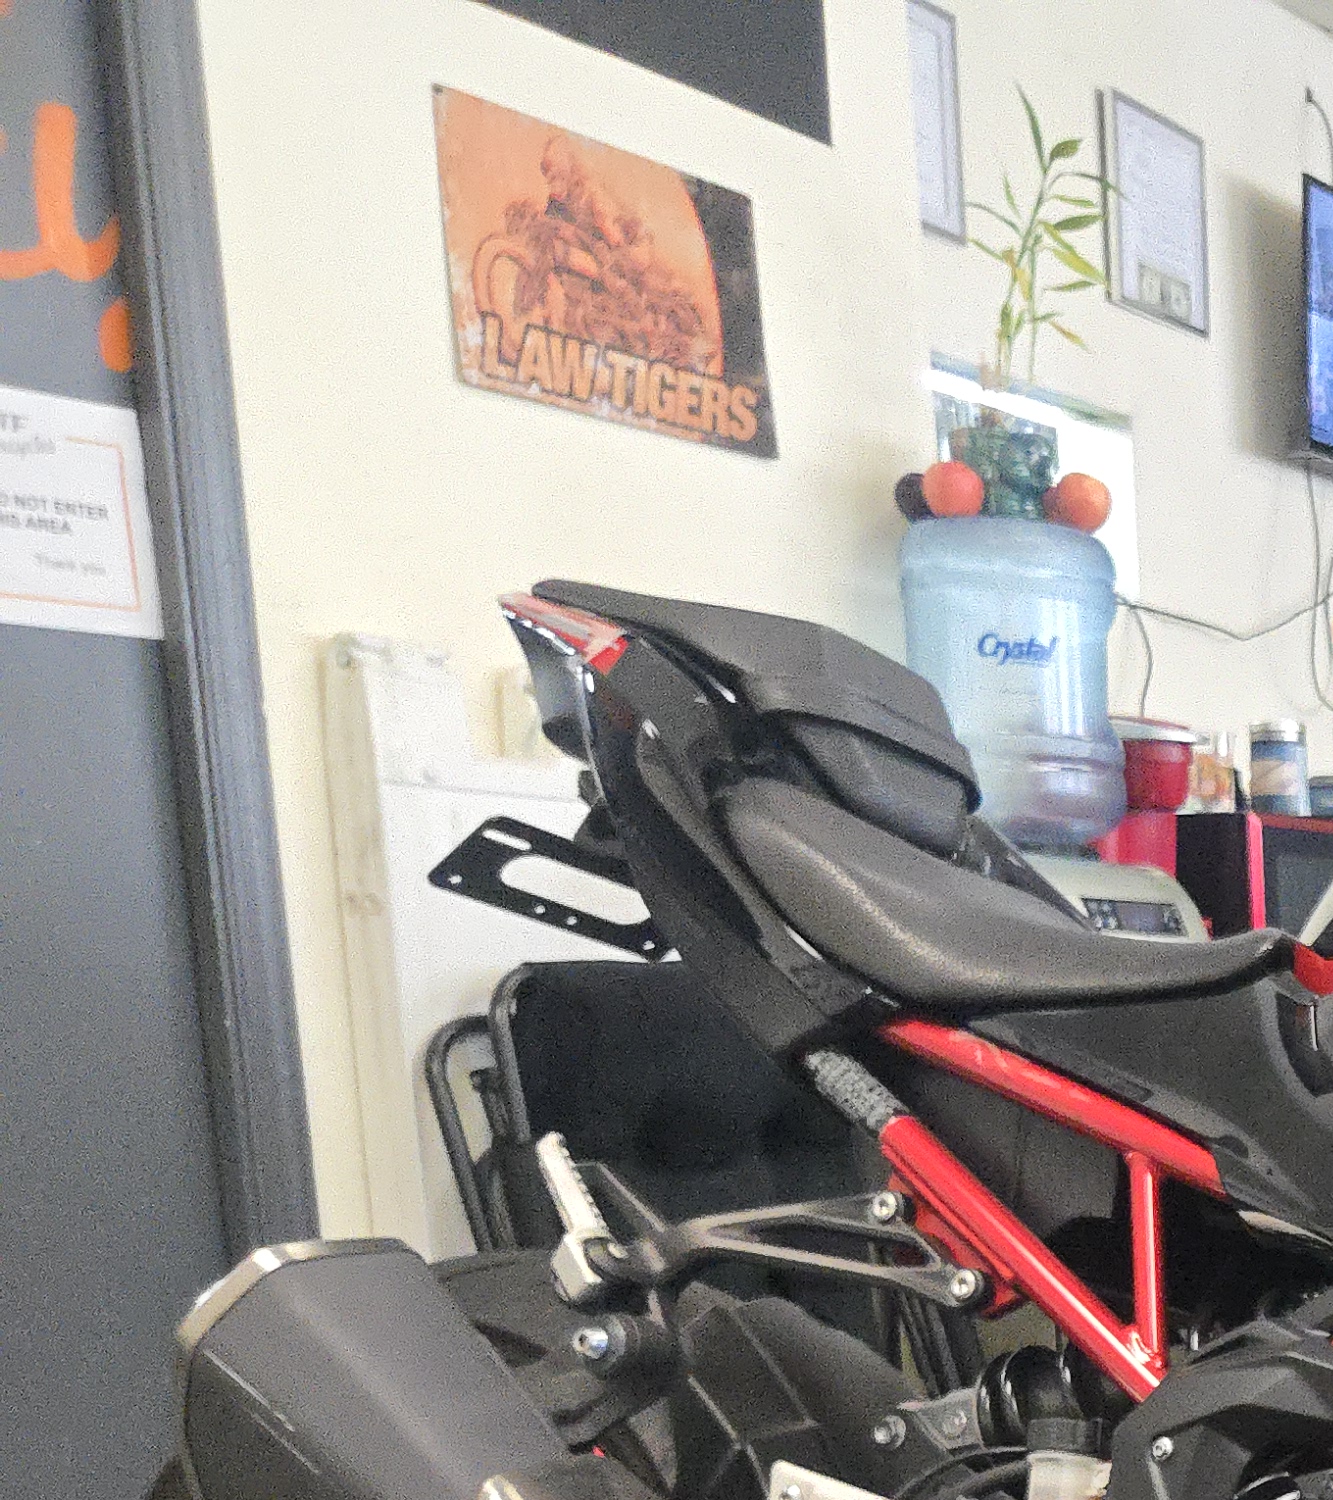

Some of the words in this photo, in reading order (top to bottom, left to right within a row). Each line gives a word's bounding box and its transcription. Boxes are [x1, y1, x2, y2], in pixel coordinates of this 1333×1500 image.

[480, 311, 598, 402] LAW
[602, 345, 758, 441] TIGERS
[14, 494, 47, 512] NOT
[53, 499, 109, 520] ENTER
[25, 515, 73, 535] AREA
[977, 632, 1059, 666] Crystal
